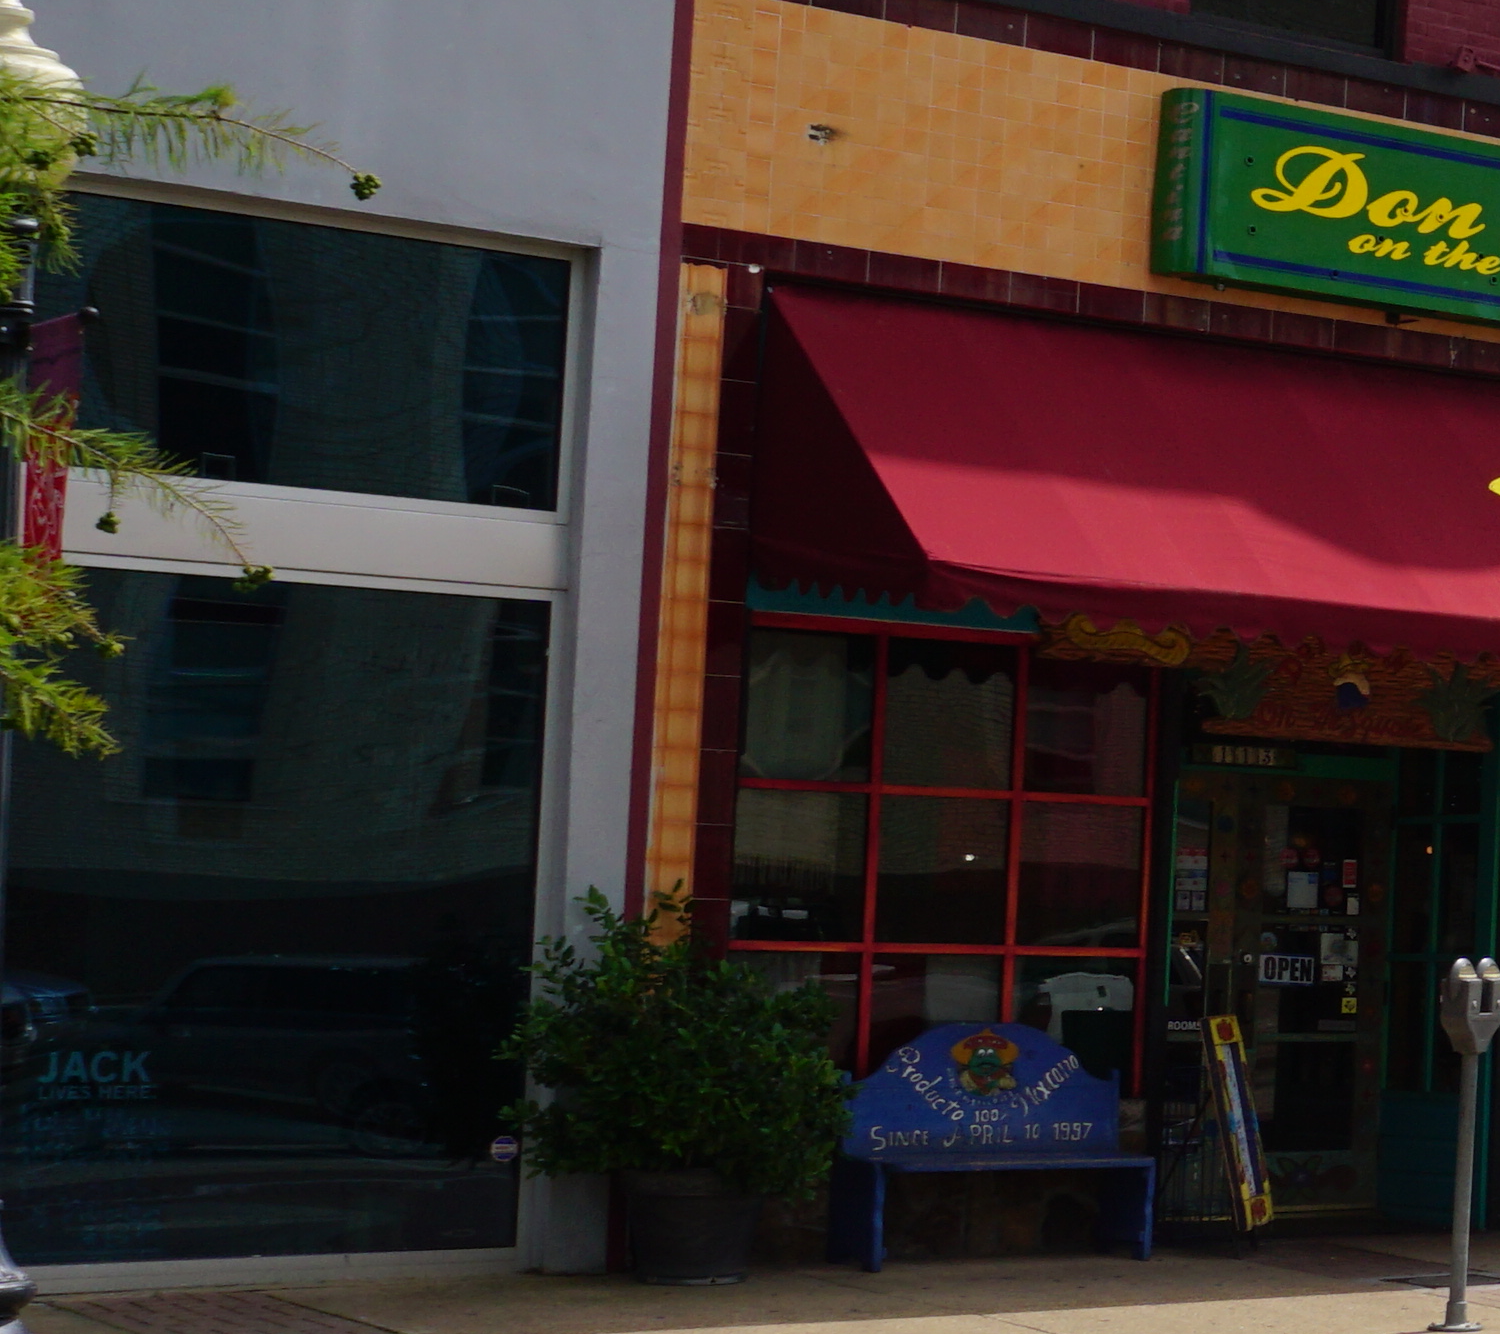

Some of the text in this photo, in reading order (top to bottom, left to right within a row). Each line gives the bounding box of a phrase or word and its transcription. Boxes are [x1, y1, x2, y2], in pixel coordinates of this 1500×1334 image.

[1250, 145, 1486, 241] Don
[1347, 231, 1412, 262] on
[1263, 956, 1313, 983] OPEN
[36, 1050, 153, 1085] JACK
[37, 1084, 94, 1101] LIVES
[887, 1046, 965, 1122] Producto
[942, 1123, 1015, 1148] APRIL
[1024, 1122, 1042, 1139] 10
